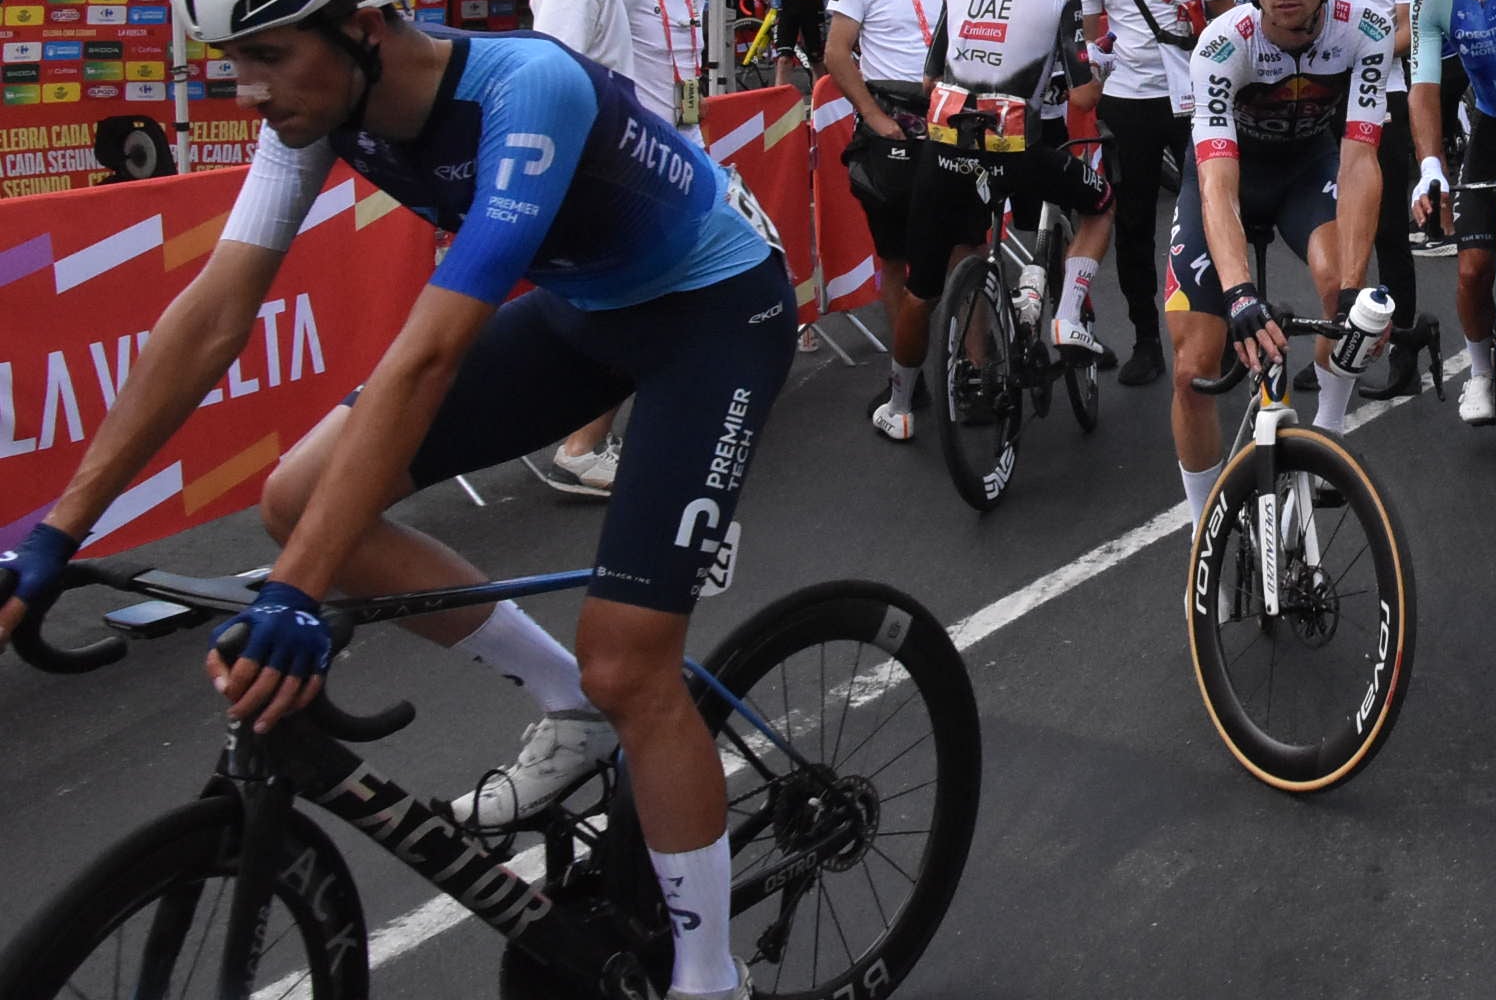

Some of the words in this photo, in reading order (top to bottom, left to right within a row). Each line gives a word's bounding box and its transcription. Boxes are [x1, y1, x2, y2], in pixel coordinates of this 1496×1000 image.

[963, 24, 1003, 37] Emirates
[1362, 8, 1392, 36] BORA
[953, 47, 1002, 66] XRG
[1200, 34, 1228, 59] BORA
[1258, 53, 1282, 62] BOSS
[1358, 53, 1384, 109] BOSS
[932, 89, 949, 123] 7
[995, 100, 1010, 136] 7
[1208, 74, 1232, 127] BOSS
[0, 125, 48, 152] ELEBRA
[51, 122, 91, 147] CADA
[202, 143, 242, 164] CADA
[3, 150, 46, 176] CADA
[48, 147, 104, 173] SEGUN
[617, 117, 695, 196] FACTOR
[1082, 163, 1104, 192] UAE
[485, 206, 519, 225] TECH
[487, 195, 540, 218] PREMIER
[1339, 331, 1360, 366] GARMIN
[0, 350, 85, 459] LA
[89, 292, 326, 411] VLTA
[705, 387, 752, 489] PREMIER
[726, 428, 755, 492] TECH
[1196, 490, 1229, 616] roval
[1263, 501, 1275, 595] SPECIALIZED
[1355, 599, 1391, 736] roval
[316, 759, 553, 940] FACTOR
[763, 850, 819, 894] OSTRO
[278, 850, 358, 977] ACK
